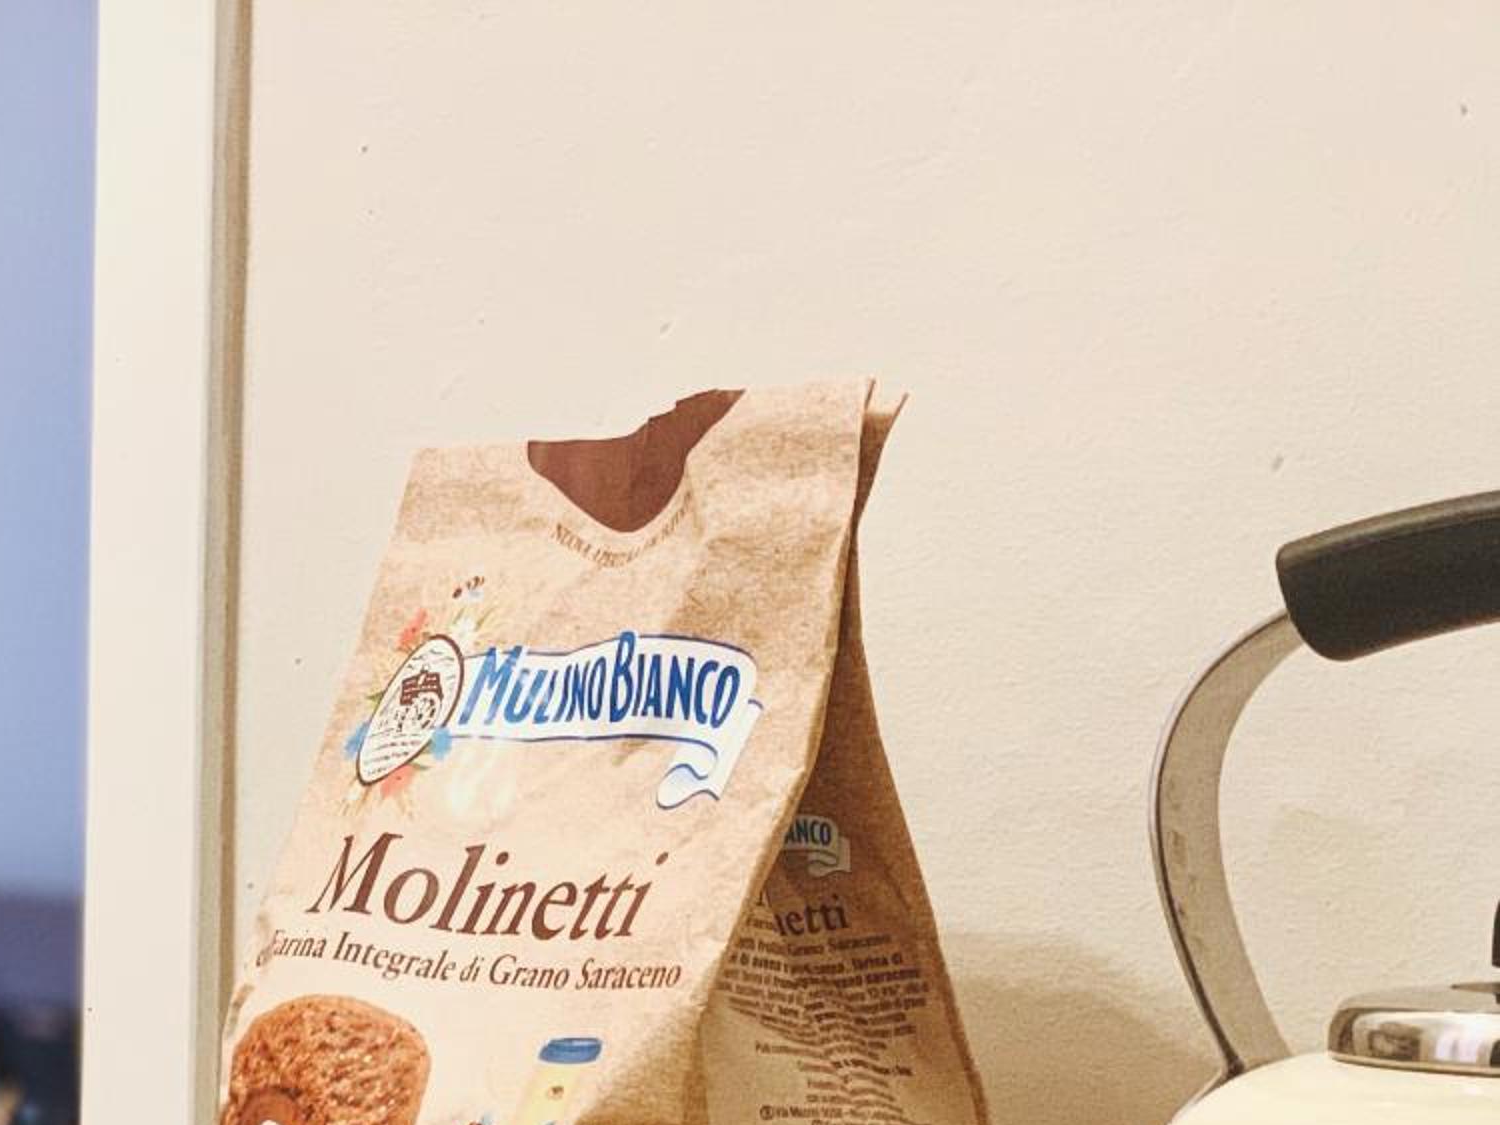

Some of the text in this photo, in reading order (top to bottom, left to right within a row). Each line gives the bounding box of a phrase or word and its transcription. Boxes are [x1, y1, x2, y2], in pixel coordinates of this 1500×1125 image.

[304, 831, 670, 941] Molinetti
[332, 931, 456, 981] Integrale
[460, 957, 481, 982] di
[489, 954, 571, 990] Grano
[575, 958, 681, 990] Saraceno
